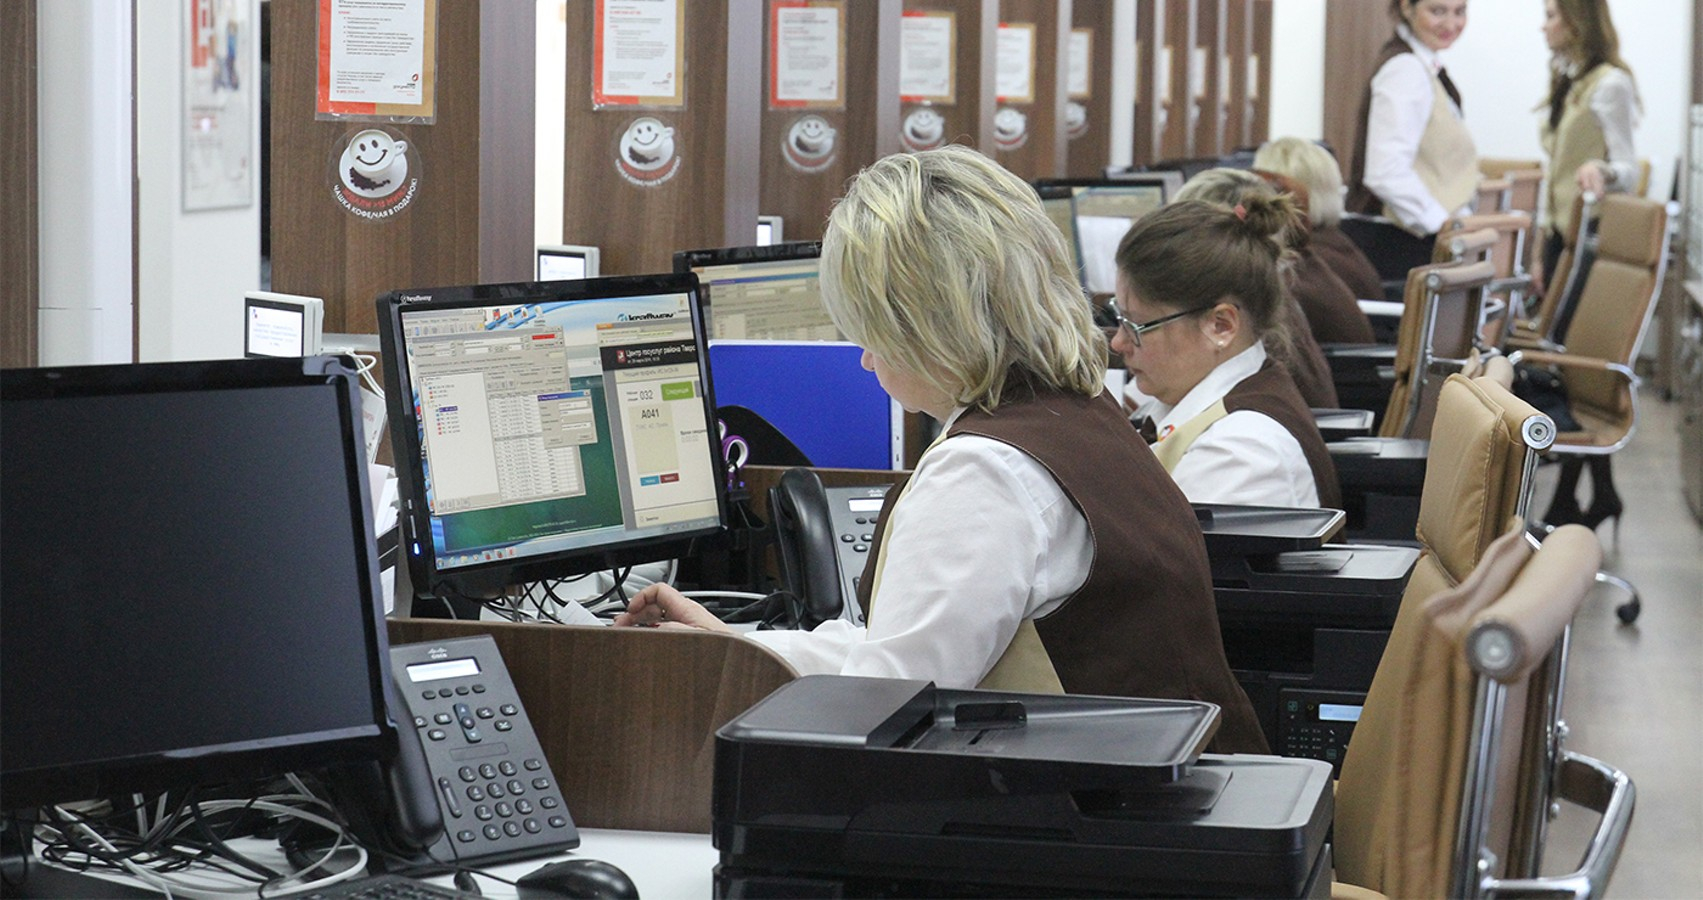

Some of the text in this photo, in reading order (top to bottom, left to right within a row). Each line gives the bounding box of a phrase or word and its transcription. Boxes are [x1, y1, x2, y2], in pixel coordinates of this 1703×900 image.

[332, 184, 352, 210] ЧАШКА
[351, 206, 389, 220] КОФЕ/ЧАЯ
[388, 208, 394, 216] В
[639, 389, 654, 400] 032
